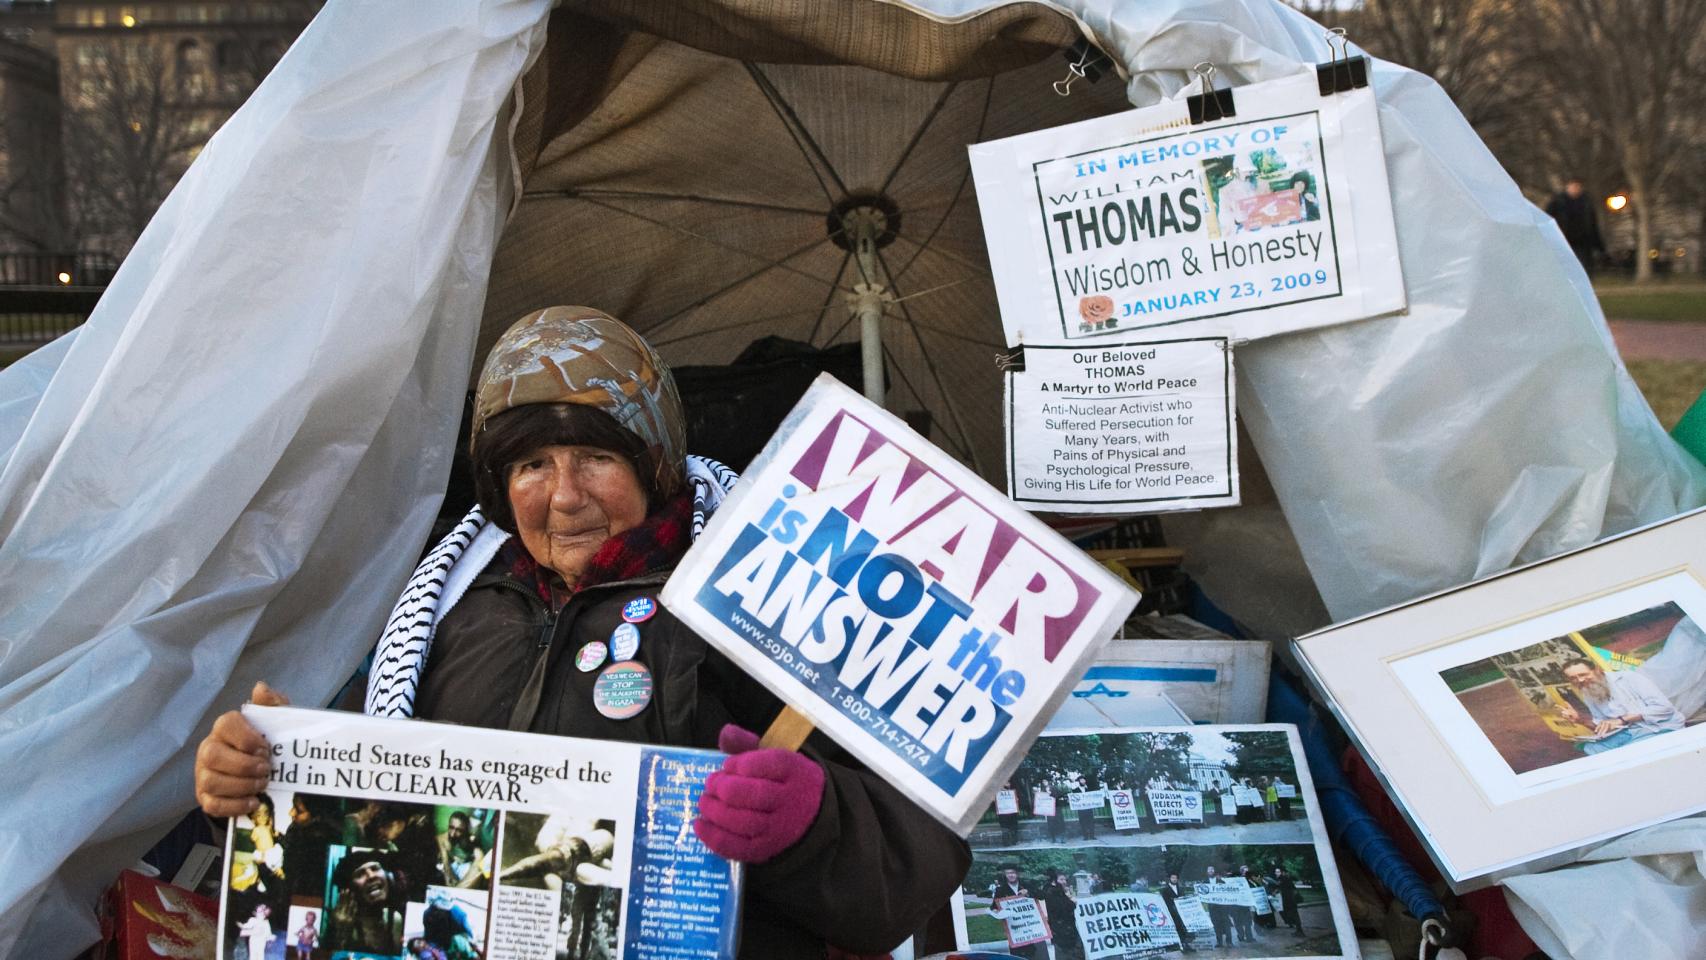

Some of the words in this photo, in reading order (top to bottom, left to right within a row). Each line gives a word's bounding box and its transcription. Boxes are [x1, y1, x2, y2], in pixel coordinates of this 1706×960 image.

[1074, 158, 1107, 178] IN
[1118, 132, 1240, 170] MEMORY
[1250, 125, 1289, 144] OF
[1049, 168, 1196, 206] WILLIAM
[1053, 187, 1202, 255] THOMAS
[1064, 253, 1171, 297] Wisdom
[1181, 246, 1203, 277] &
[1210, 228, 1323, 272] Honesty
[1122, 287, 1221, 317] JANUARY
[1229, 282, 1264, 300] 23,
[1271, 269, 1328, 292] 2009
[1073, 352, 1098, 364] Our
[1102, 349, 1156, 363] Beloved
[1085, 365, 1145, 379] THOMAS
[1041, 382, 1049, 392] A
[1053, 382, 1093, 395] Martyr
[1097, 383, 1111, 394] to
[1114, 381, 1153, 393] World
[1157, 378, 1197, 389] Peace
[1042, 403, 1116, 416] Anti-Nuclear
[1119, 401, 1164, 414] Activist
[1166, 399, 1193, 410] who
[1045, 418, 1096, 431] Suffered
[1100, 416, 1173, 430] Persecution
[1177, 414, 1194, 426] for
[1065, 435, 1098, 448] Many
[1102, 433, 1141, 446] Years,
[1145, 432, 1170, 443] with
[1053, 448, 1088, 461] Pains
[1091, 448, 1104, 461] of
[1107, 447, 1159, 461] Physical
[1163, 445, 1186, 457] and
[1046, 464, 1131, 478] Psychological
[1135, 461, 1193, 473] Pressure,
[1024, 477, 1062, 492] Giving
[1065, 478, 1085, 490] His
[1089, 477, 1112, 490] Life
[1115, 477, 1132, 489] for
[1135, 475, 1171, 488] World
[811, 412, 1080, 661] WAR
[757, 484, 808, 545] is
[798, 507, 974, 650] NOT
[948, 627, 1026, 707] the
[713, 535, 997, 774] ANSWER
[731, 612, 820, 684] www.sojo.net
[831, 686, 931, 766] 1-800-714-7474
[293, 739, 362, 763] United
[370, 744, 431, 769] States
[439, 749, 473, 772] has
[481, 759, 569, 785] engaged
[578, 762, 612, 784] the
[268, 762, 298, 784] rld
[306, 765, 326, 786] in
[335, 768, 457, 797] NUCLEAR
[466, 779, 528, 804] WAR.
[680, 902, 698, 911] World
[700, 903, 720, 913] Health
[1079, 898, 1139, 917] JUDAISM
[1086, 914, 1143, 934] REJECTS
[1087, 930, 1151, 953] ZIONISM
